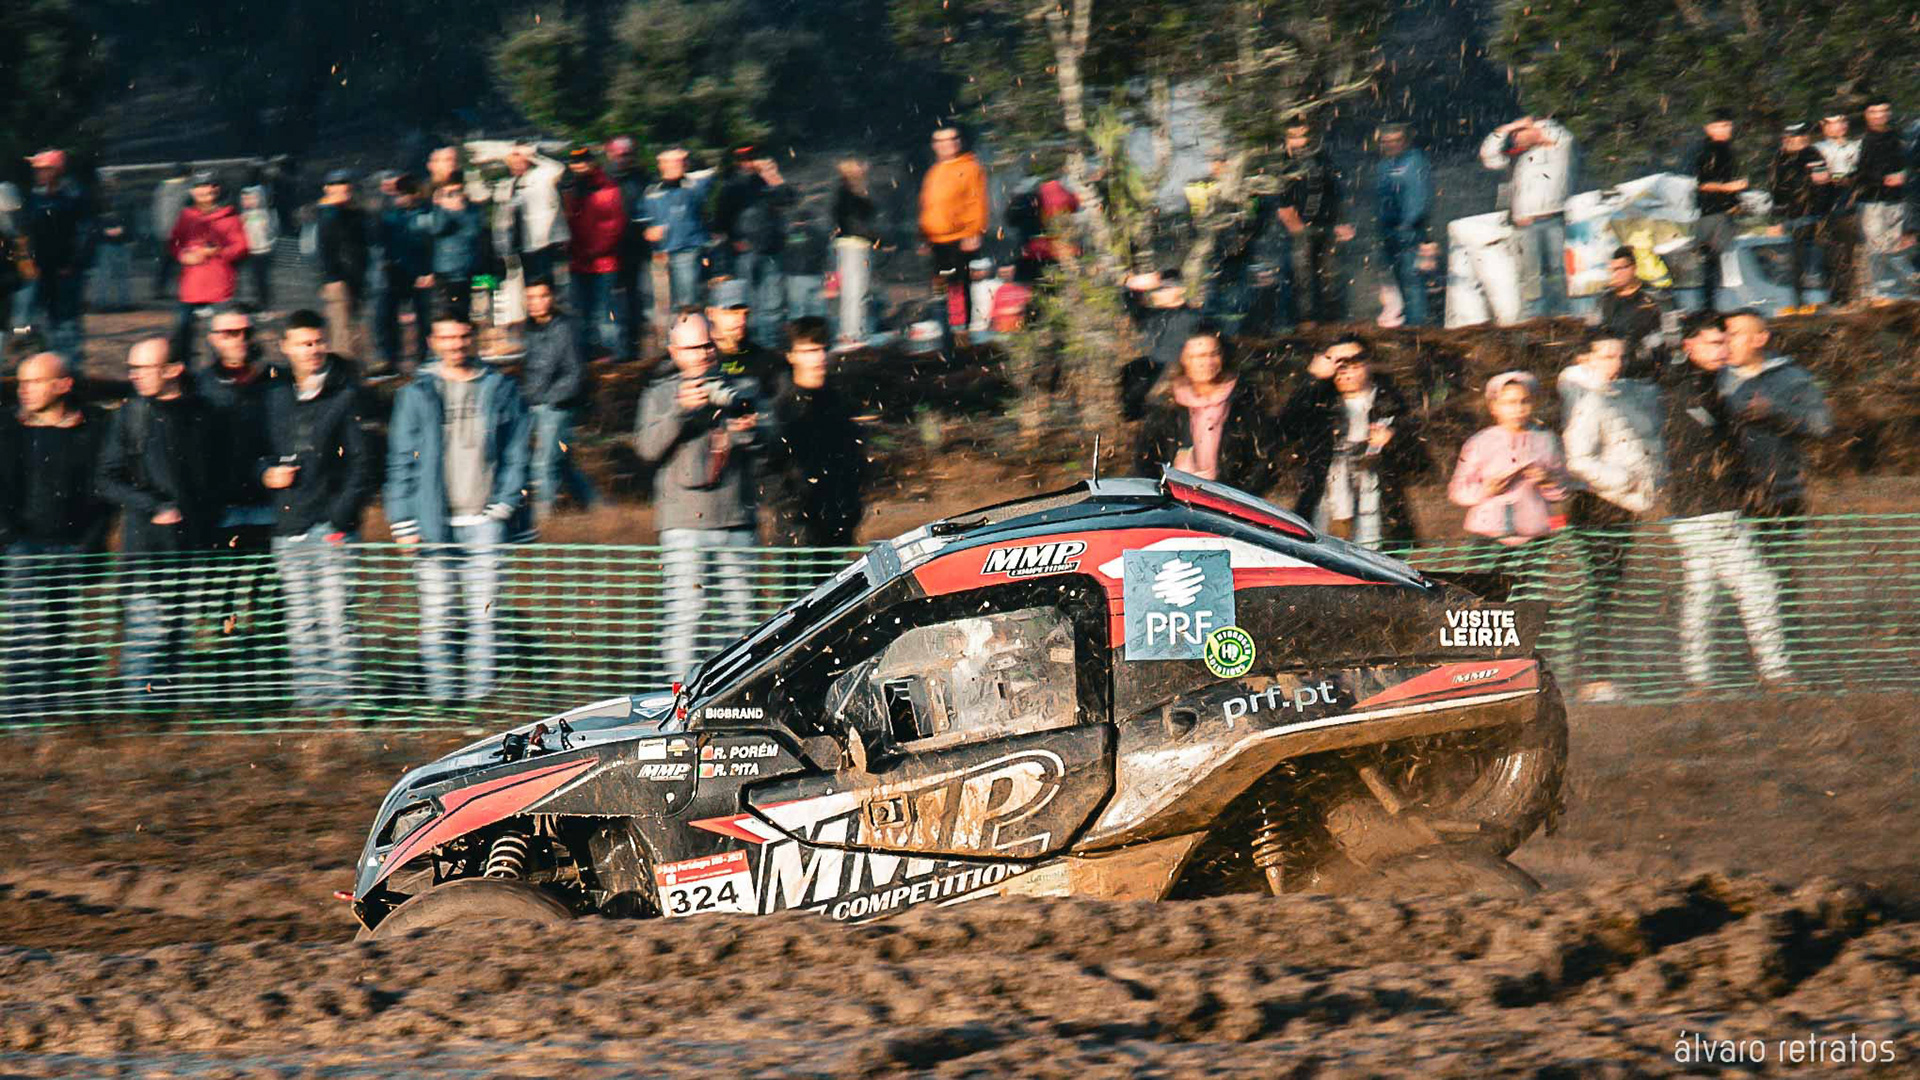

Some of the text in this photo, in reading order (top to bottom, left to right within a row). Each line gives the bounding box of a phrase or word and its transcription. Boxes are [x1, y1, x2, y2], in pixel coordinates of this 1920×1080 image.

[984, 541, 1085, 573] MMP
[1146, 610, 1213, 646] PRF
[1445, 609, 1515, 628] VISITE
[1439, 627, 1521, 647] LEIRIA
[1454, 668, 1499, 683] MMP
[705, 707, 764, 720] BIGBRAND
[1222, 681, 1337, 729] prf.pt
[713, 742, 779, 760] R. PORÉM
[639, 763, 692, 778] MMP
[713, 763, 760, 776] R. PITA
[669, 880, 740, 914] 324
